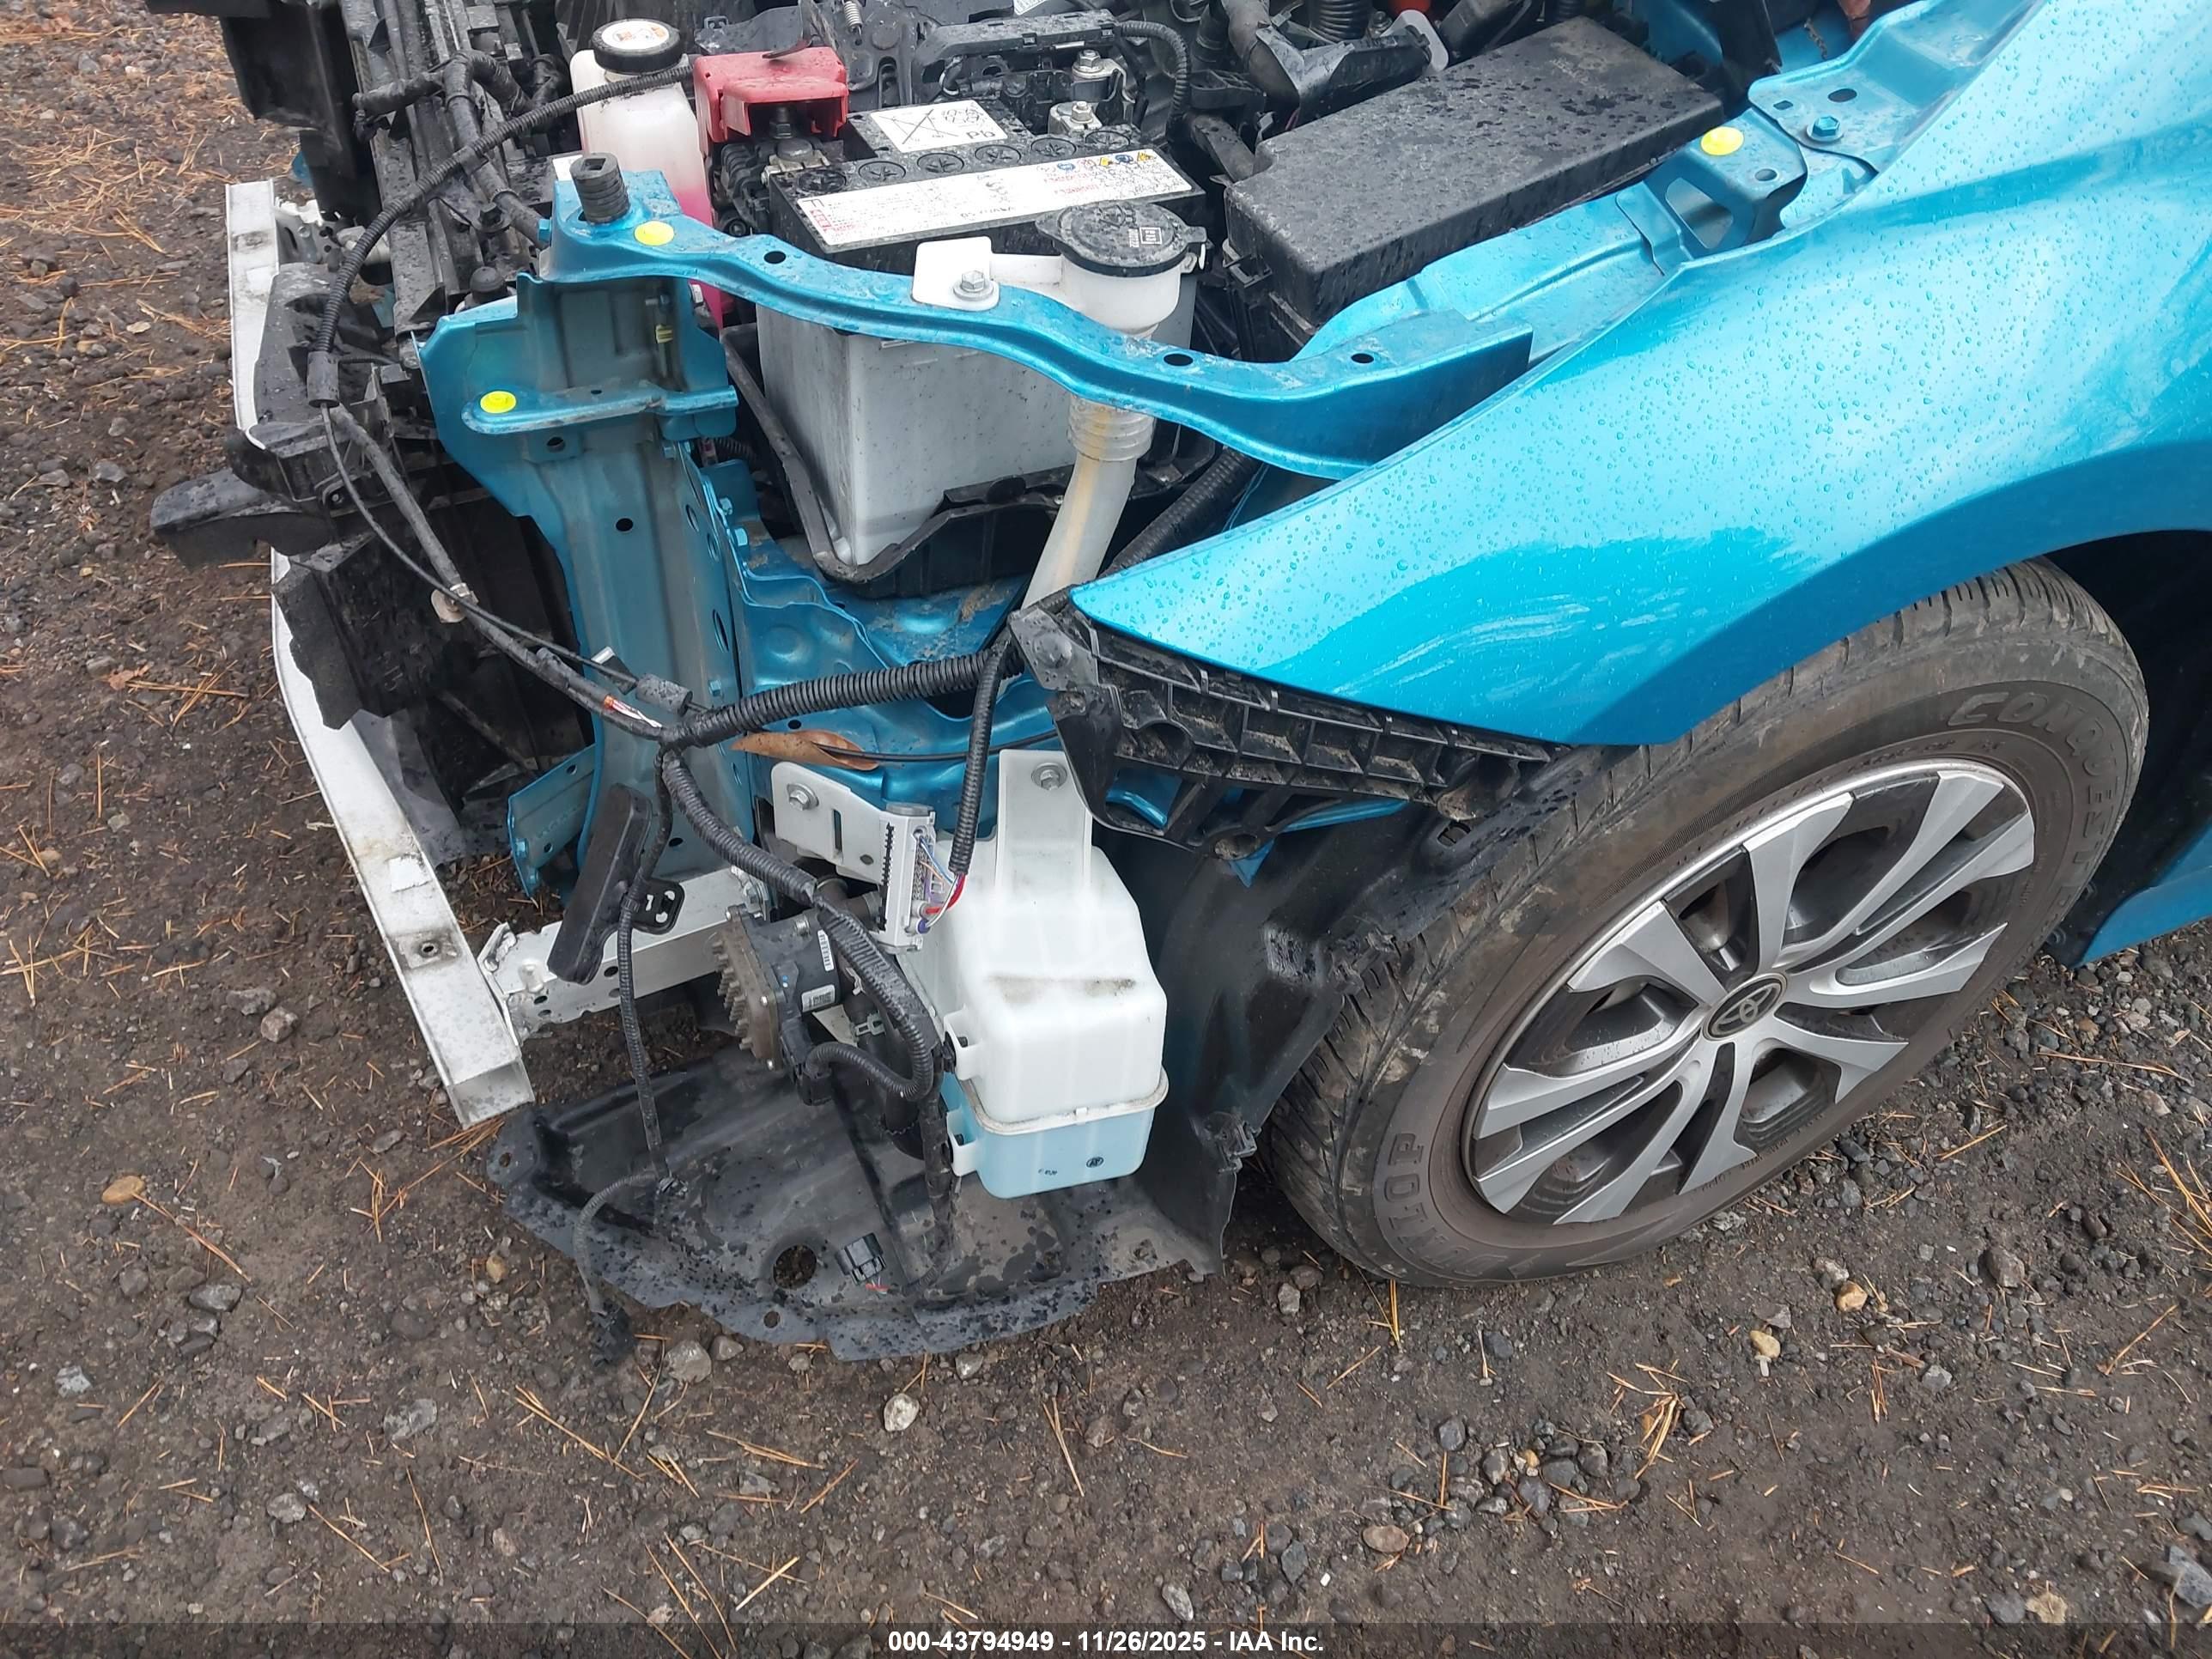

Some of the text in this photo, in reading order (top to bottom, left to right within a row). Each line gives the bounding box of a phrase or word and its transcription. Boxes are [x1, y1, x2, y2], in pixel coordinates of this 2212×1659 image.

[966, 130, 996, 140] Pb
[1947, 690, 2119, 873] CONQUEST
[1383, 1133, 1509, 1278] DUNLOP
